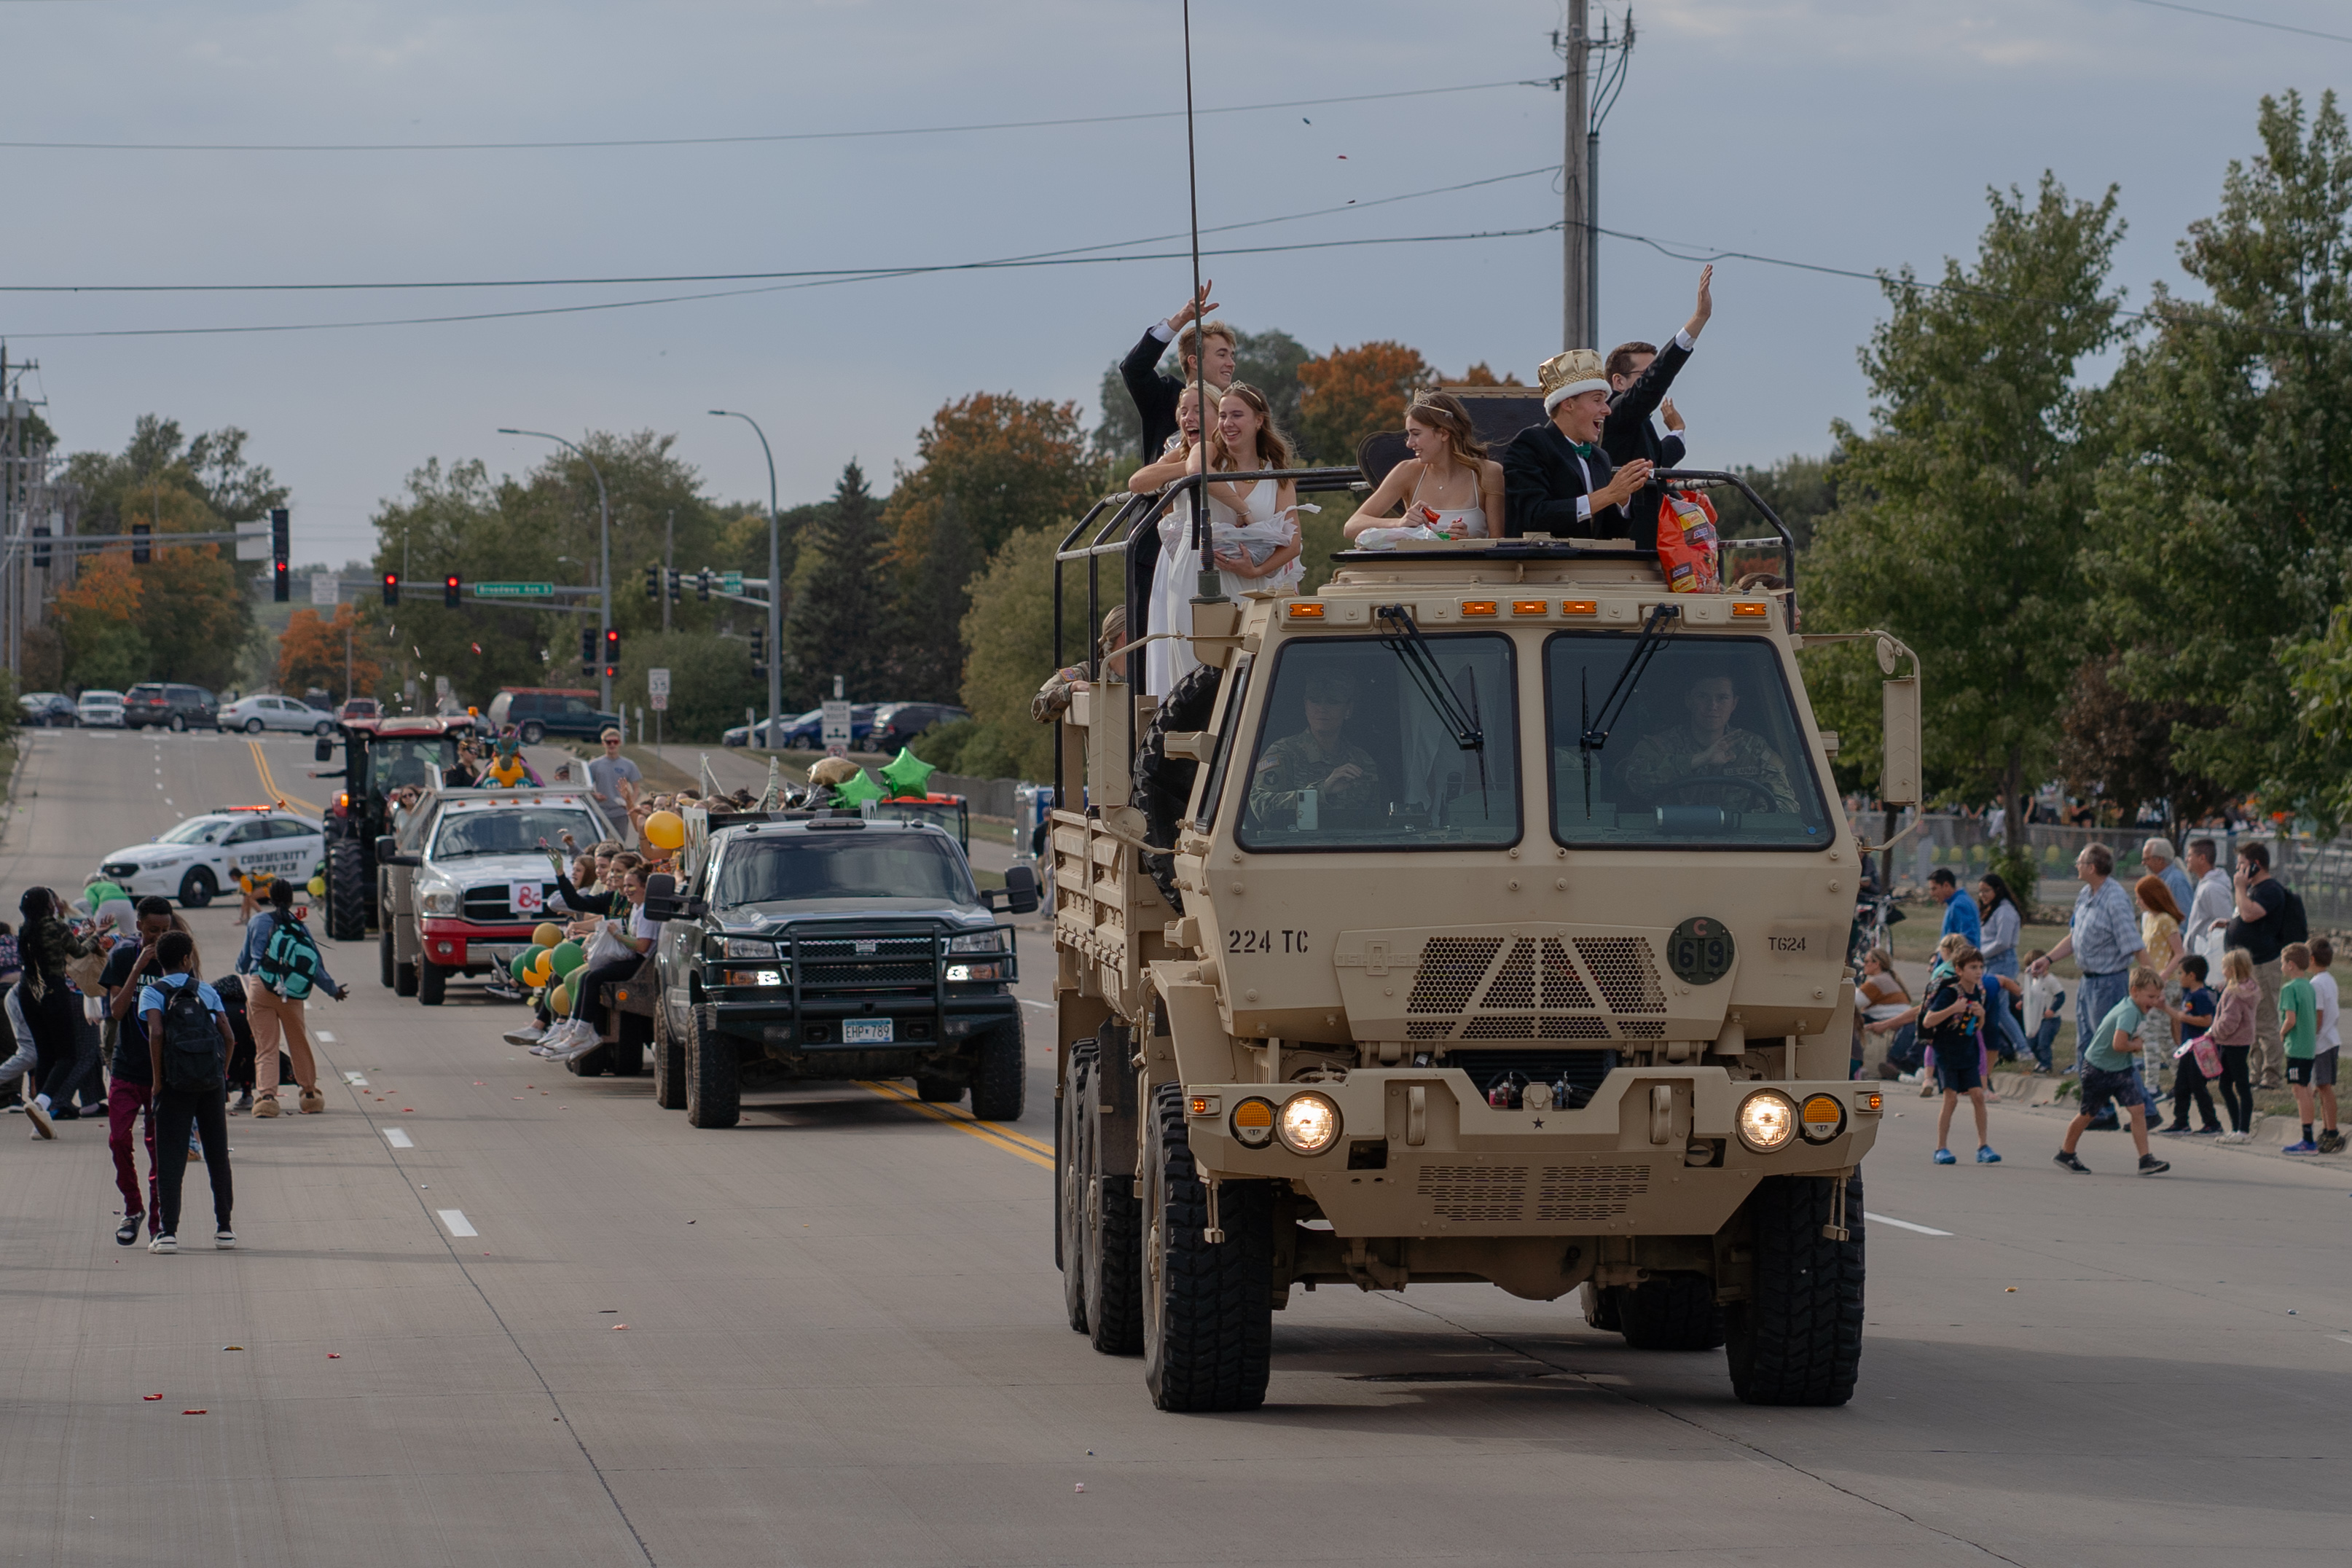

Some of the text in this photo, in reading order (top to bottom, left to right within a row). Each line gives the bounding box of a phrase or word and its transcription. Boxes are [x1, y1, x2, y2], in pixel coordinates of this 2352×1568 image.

[652, 681, 667, 691] 35
[240, 850, 308, 865] COMMUNITY
[1693, 919, 1708, 936] C
[1228, 930, 1309, 954] 224 TC
[1768, 937, 1806, 952] T624
[846, 1024, 890, 1038] EHP 789
